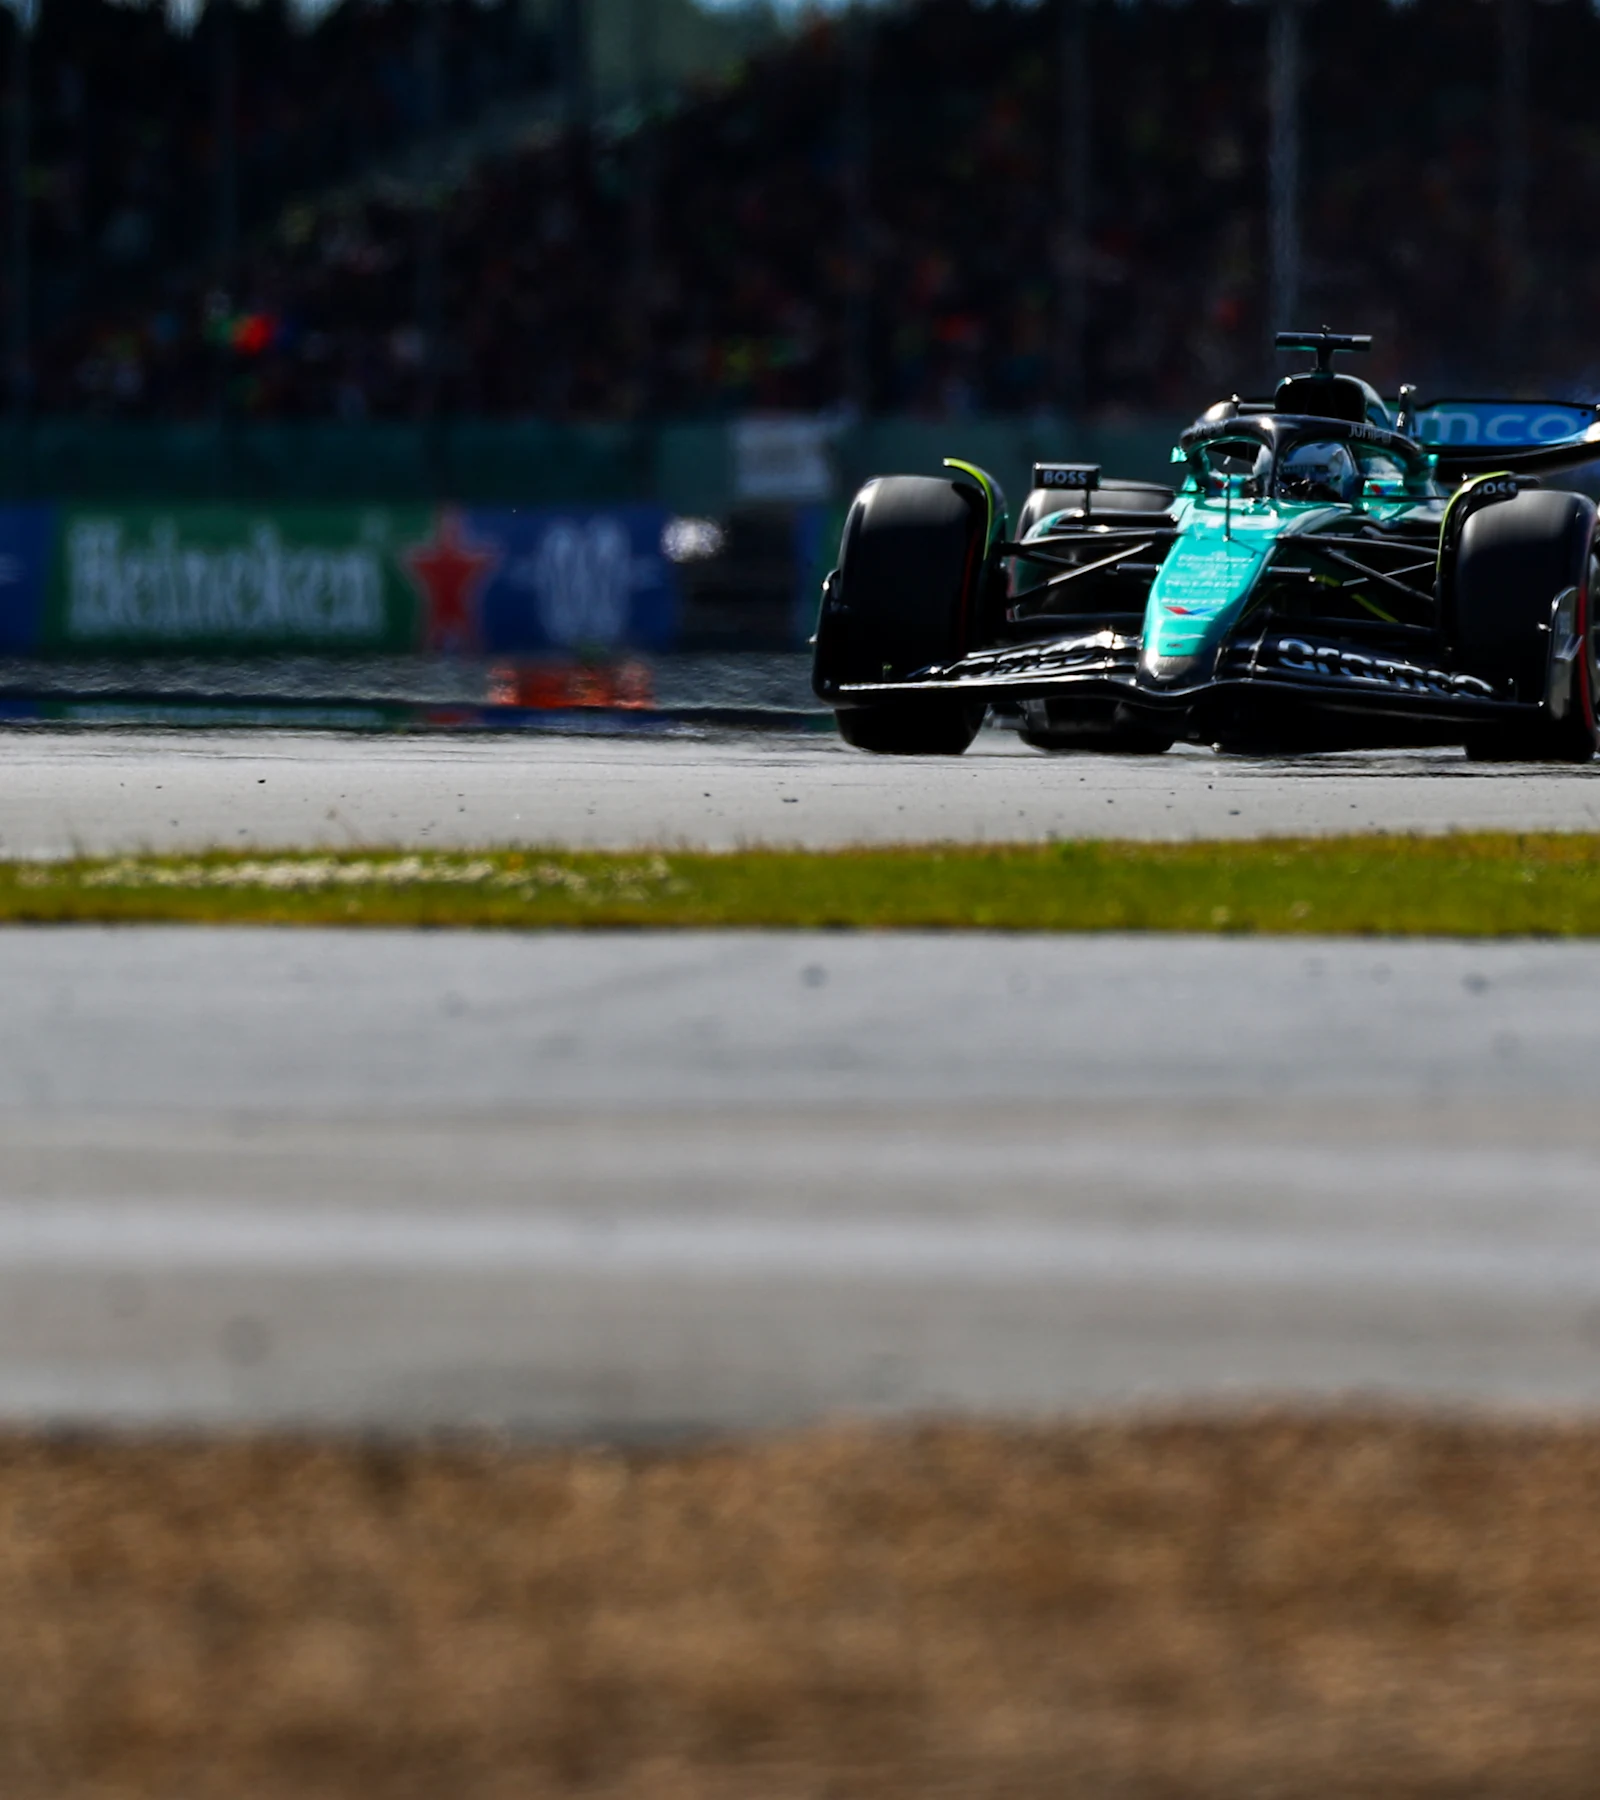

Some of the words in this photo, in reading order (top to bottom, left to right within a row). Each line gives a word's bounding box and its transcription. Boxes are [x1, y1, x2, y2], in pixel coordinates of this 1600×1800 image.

[1414, 411, 1579, 443] mco
[1042, 470, 1088, 486] BOSS
[68, 515, 384, 639] Heineken
